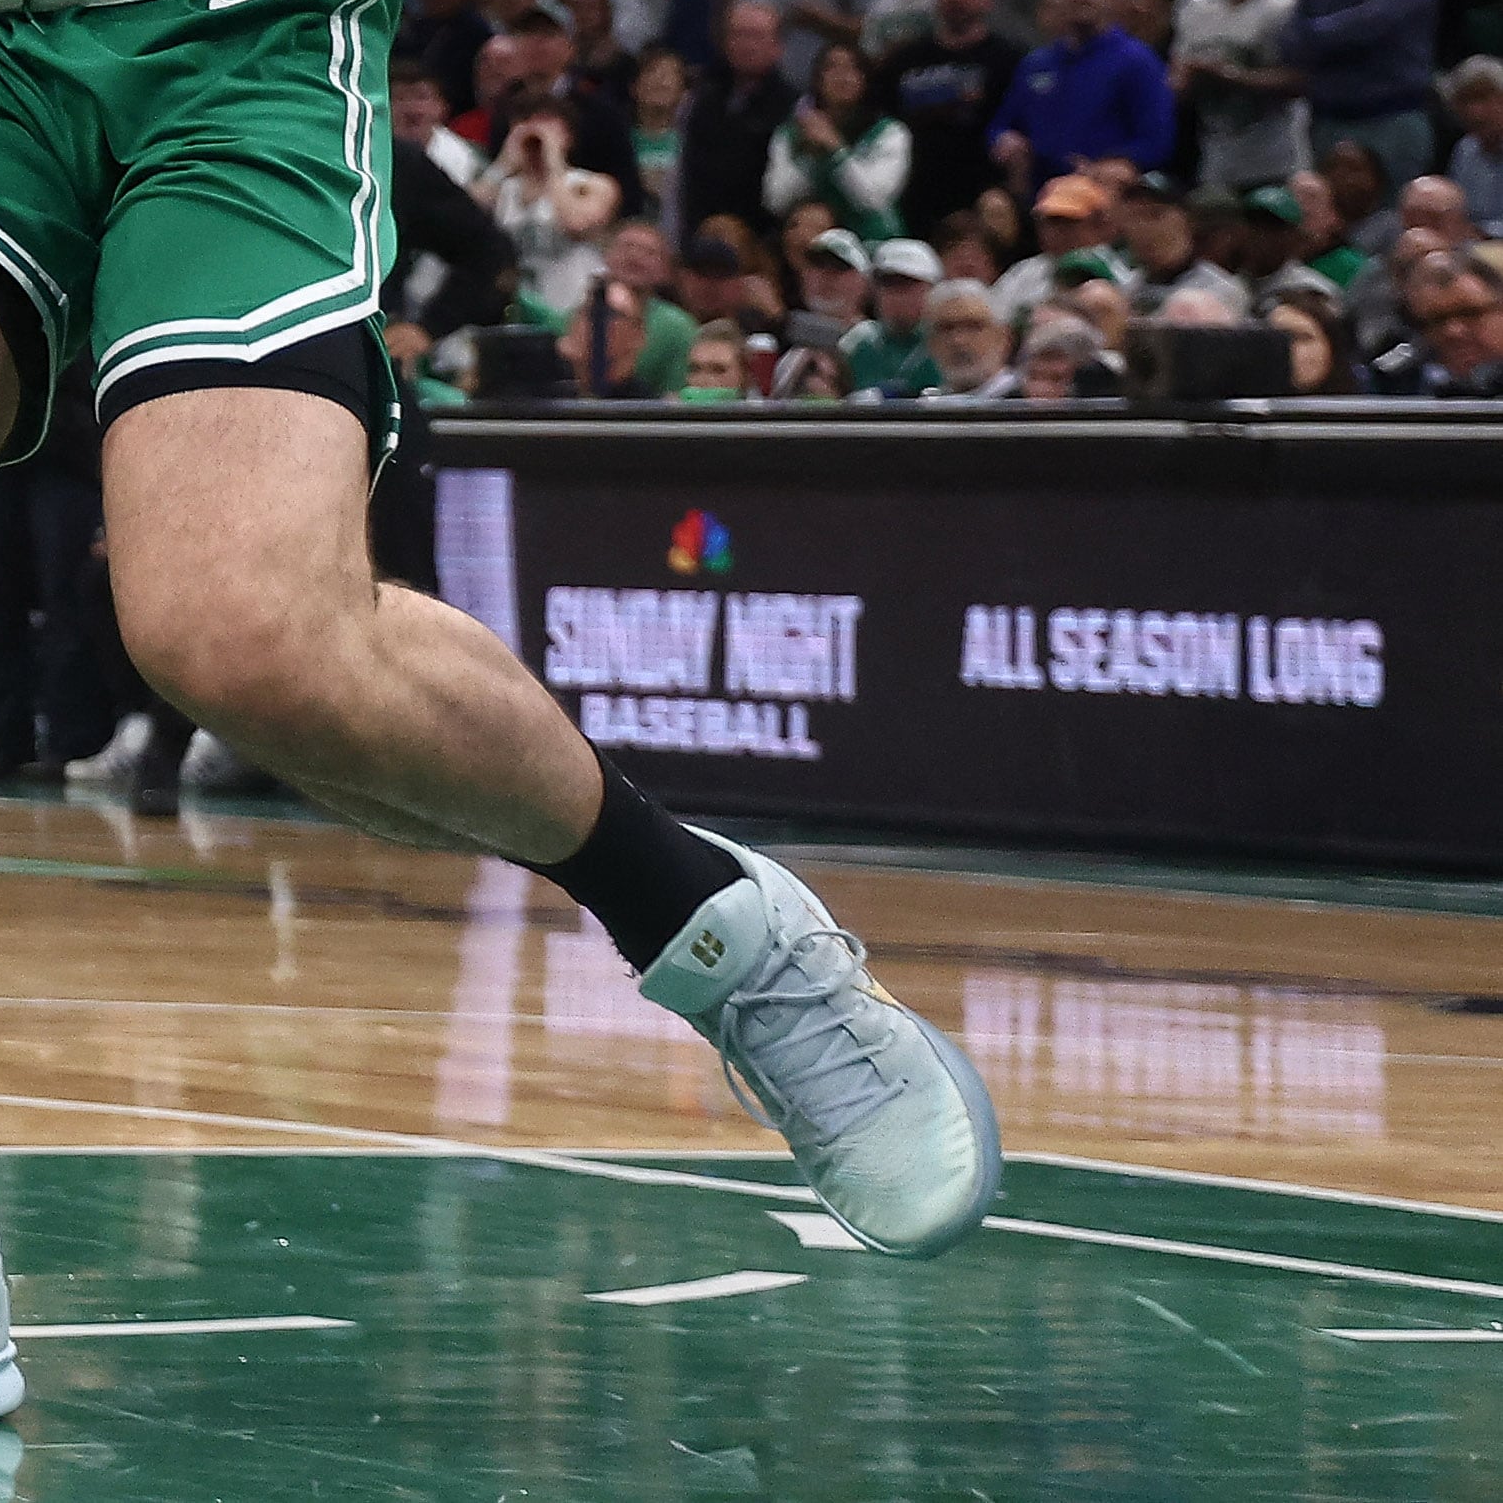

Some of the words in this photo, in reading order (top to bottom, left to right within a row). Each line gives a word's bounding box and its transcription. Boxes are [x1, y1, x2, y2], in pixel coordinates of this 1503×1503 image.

[960, 603, 1044, 691] ALL
[1047, 607, 1241, 699] SEASON
[1247, 615, 1385, 707] LONG
[580, 692, 822, 761] BASEBALL
